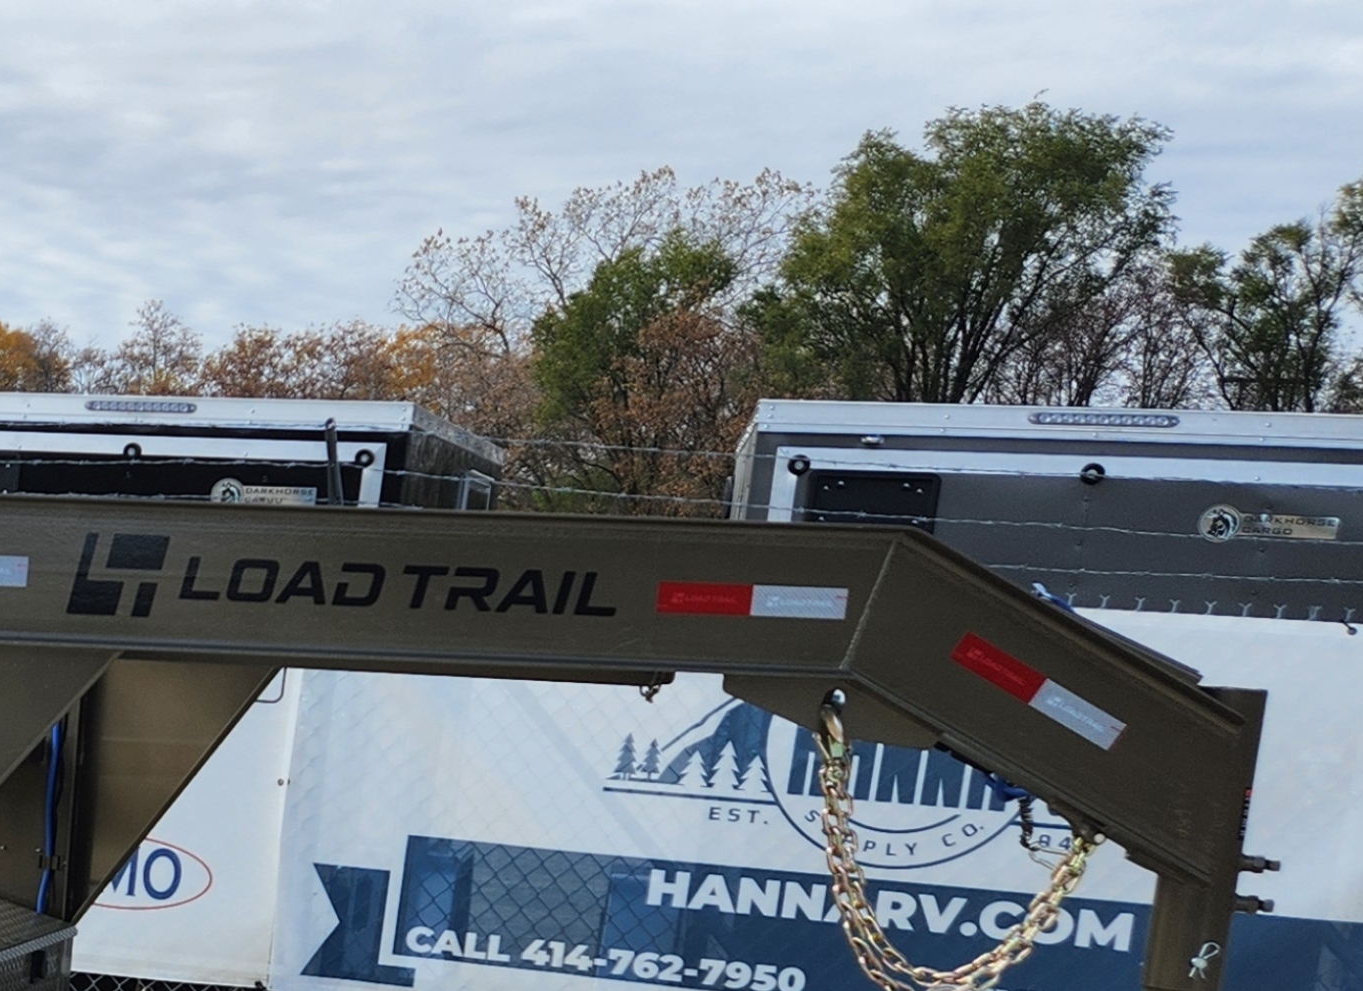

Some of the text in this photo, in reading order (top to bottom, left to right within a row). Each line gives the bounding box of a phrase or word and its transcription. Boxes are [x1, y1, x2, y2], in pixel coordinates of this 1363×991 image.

[1241, 527, 1293, 535] CARGO
[178, 557, 617, 617] LOAD TRAIL
[708, 806, 769, 825] EST.
[804, 809, 985, 856] SPLY CO.
[405, 926, 510, 962] CALL
